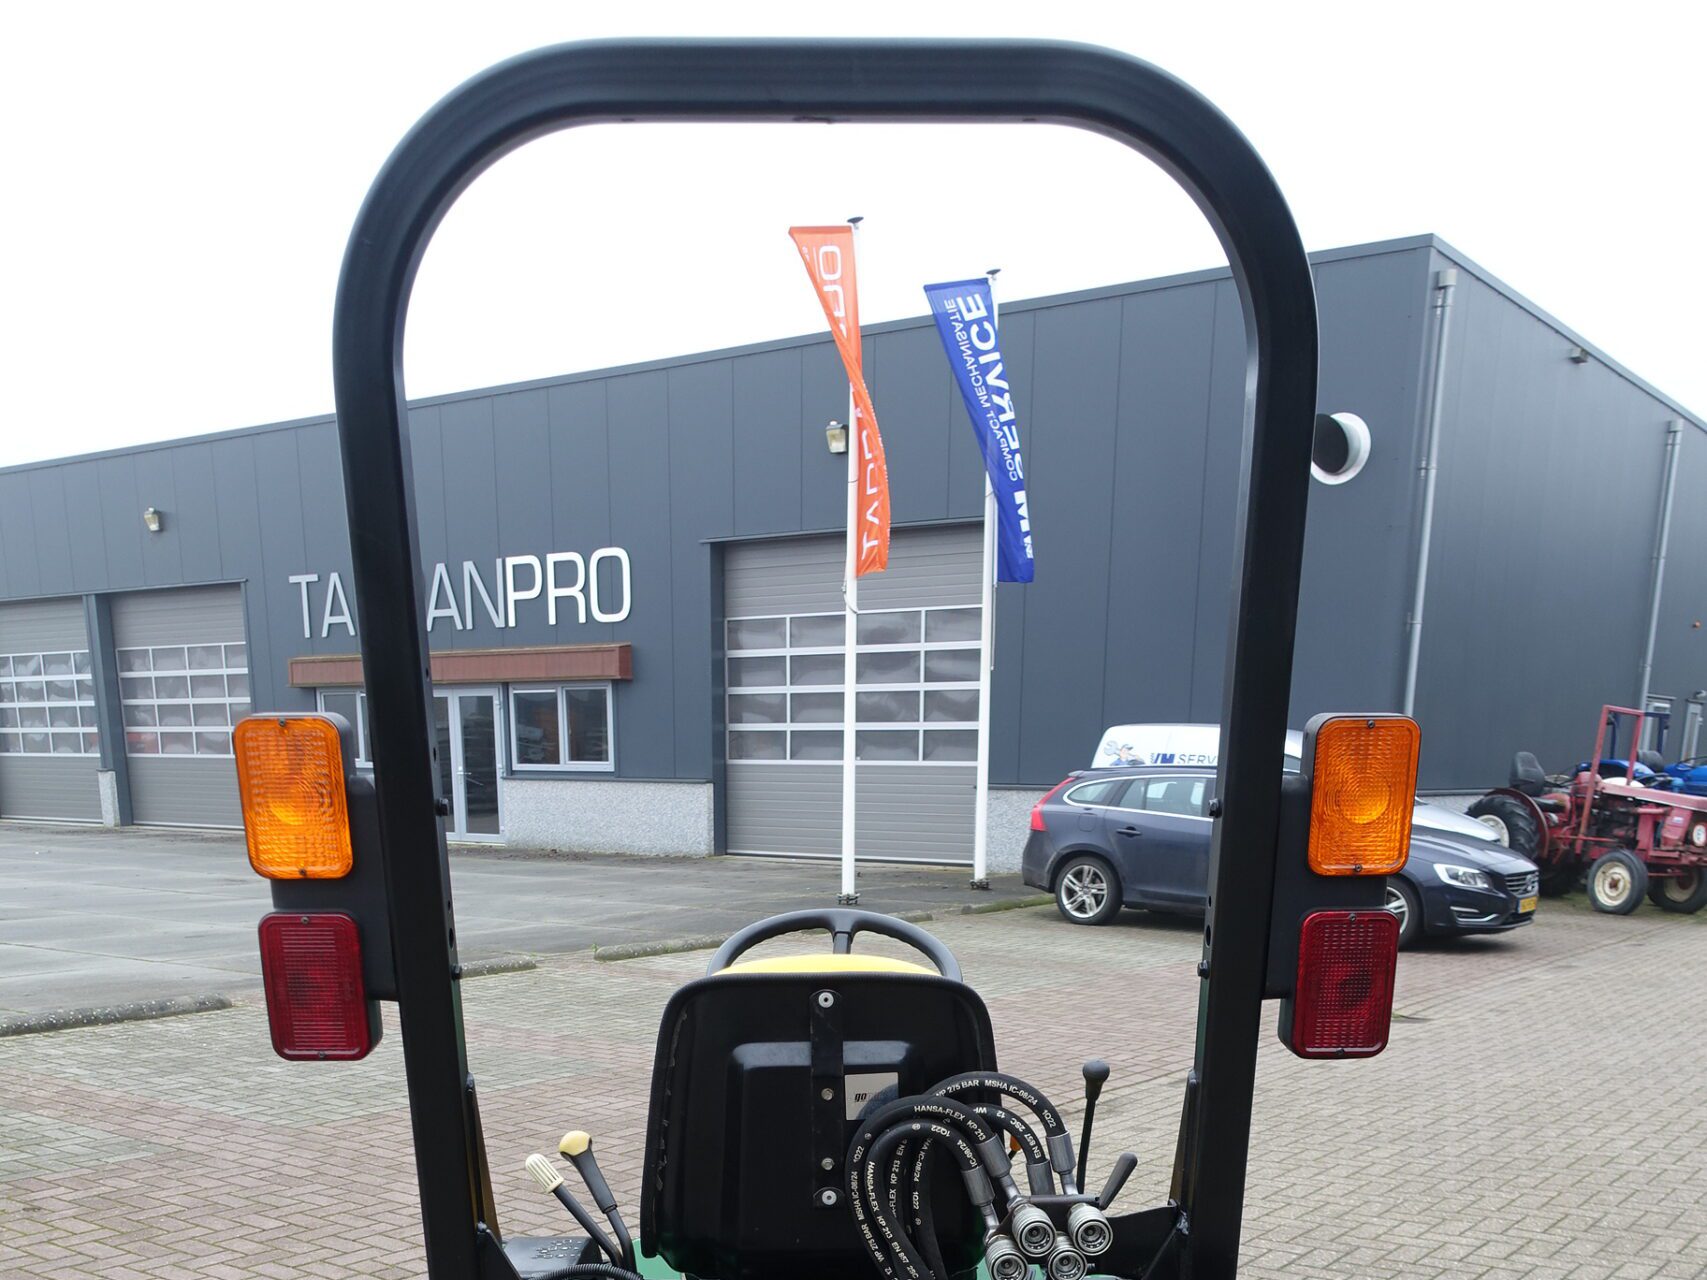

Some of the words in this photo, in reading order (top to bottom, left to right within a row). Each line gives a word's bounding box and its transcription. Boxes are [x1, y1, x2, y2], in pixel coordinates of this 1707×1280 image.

[289, 546, 631, 638] TAANPRO
[947, 1084, 961, 1094] 275
[962, 1079, 980, 1089] BAR
[985, 1079, 1008, 1091] MSHA
[914, 1105, 966, 1121] HANSA-FLEX
[996, 1109, 1006, 1119] 12
[966, 1120, 978, 1130] KP
[1010, 1117, 1026, 1132] 2SC
[974, 1128, 987, 1141] 213
[1032, 1145, 1042, 1159] EN
[891, 1160, 901, 1173] 213
[890, 1173, 898, 1185] KP
[853, 1199, 865, 1221] MSHA
[866, 1161, 880, 1212] HANSA-FLEX
[877, 1215, 886, 1226] KP
[882, 1227, 893, 1239] 213
[891, 1241, 902, 1252] EN
[861, 1223, 872, 1239] BAR
[874, 1250, 885, 1263] WP
